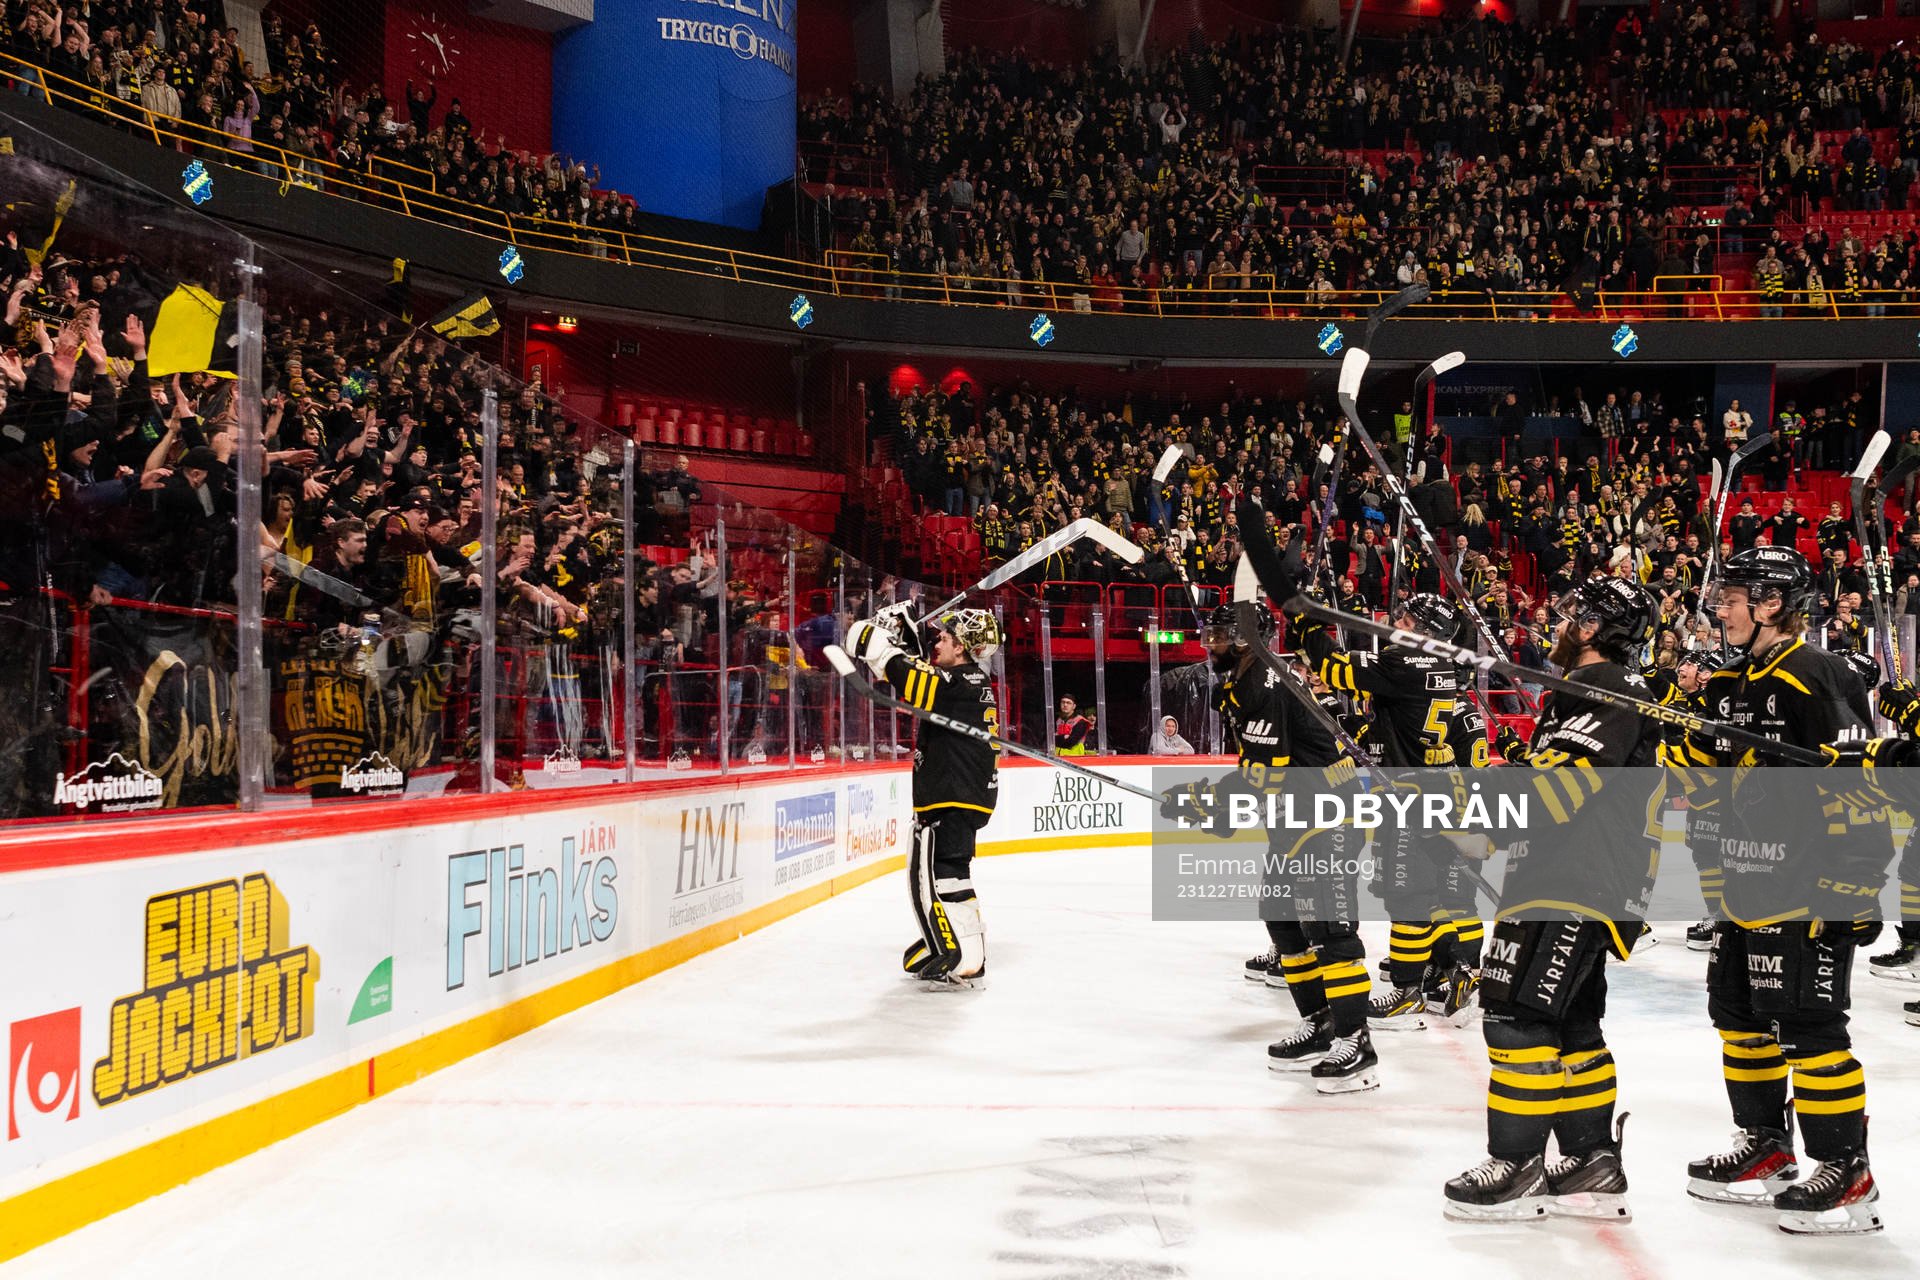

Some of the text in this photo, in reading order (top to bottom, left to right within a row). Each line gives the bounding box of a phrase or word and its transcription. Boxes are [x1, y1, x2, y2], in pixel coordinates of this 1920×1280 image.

[657, 17, 731, 48] TRYGG
[1755, 549, 1789, 562] ÅBRO
[1862, 544, 1880, 595] CCM
[1880, 545, 1893, 594] CCM
[1462, 597, 1510, 664] JETSPEE
[1389, 629, 1498, 670] CCM
[930, 712, 992, 741] CCM
[1422, 697, 1458, 749] 5
[1635, 702, 1704, 731] TACKS
[53, 772, 163, 809] Ångtvättbilen
[341, 764, 404, 793] Ångtvättbilen
[1052, 771, 1102, 803] ÅBRO
[1241, 758, 1267, 789] 19
[776, 799, 835, 854] Bemannia
[883, 818, 897, 848] AB
[1033, 801, 1123, 833] BRYGGERI
[580, 821, 617, 856] JÄRN
[674, 802, 745, 895] HMT
[1816, 876, 1880, 899] CCM
[145, 873, 275, 990] EURO
[446, 836, 618, 992] Flinks
[933, 901, 957, 950] CCM
[93, 946, 312, 1107] JACKPOT
